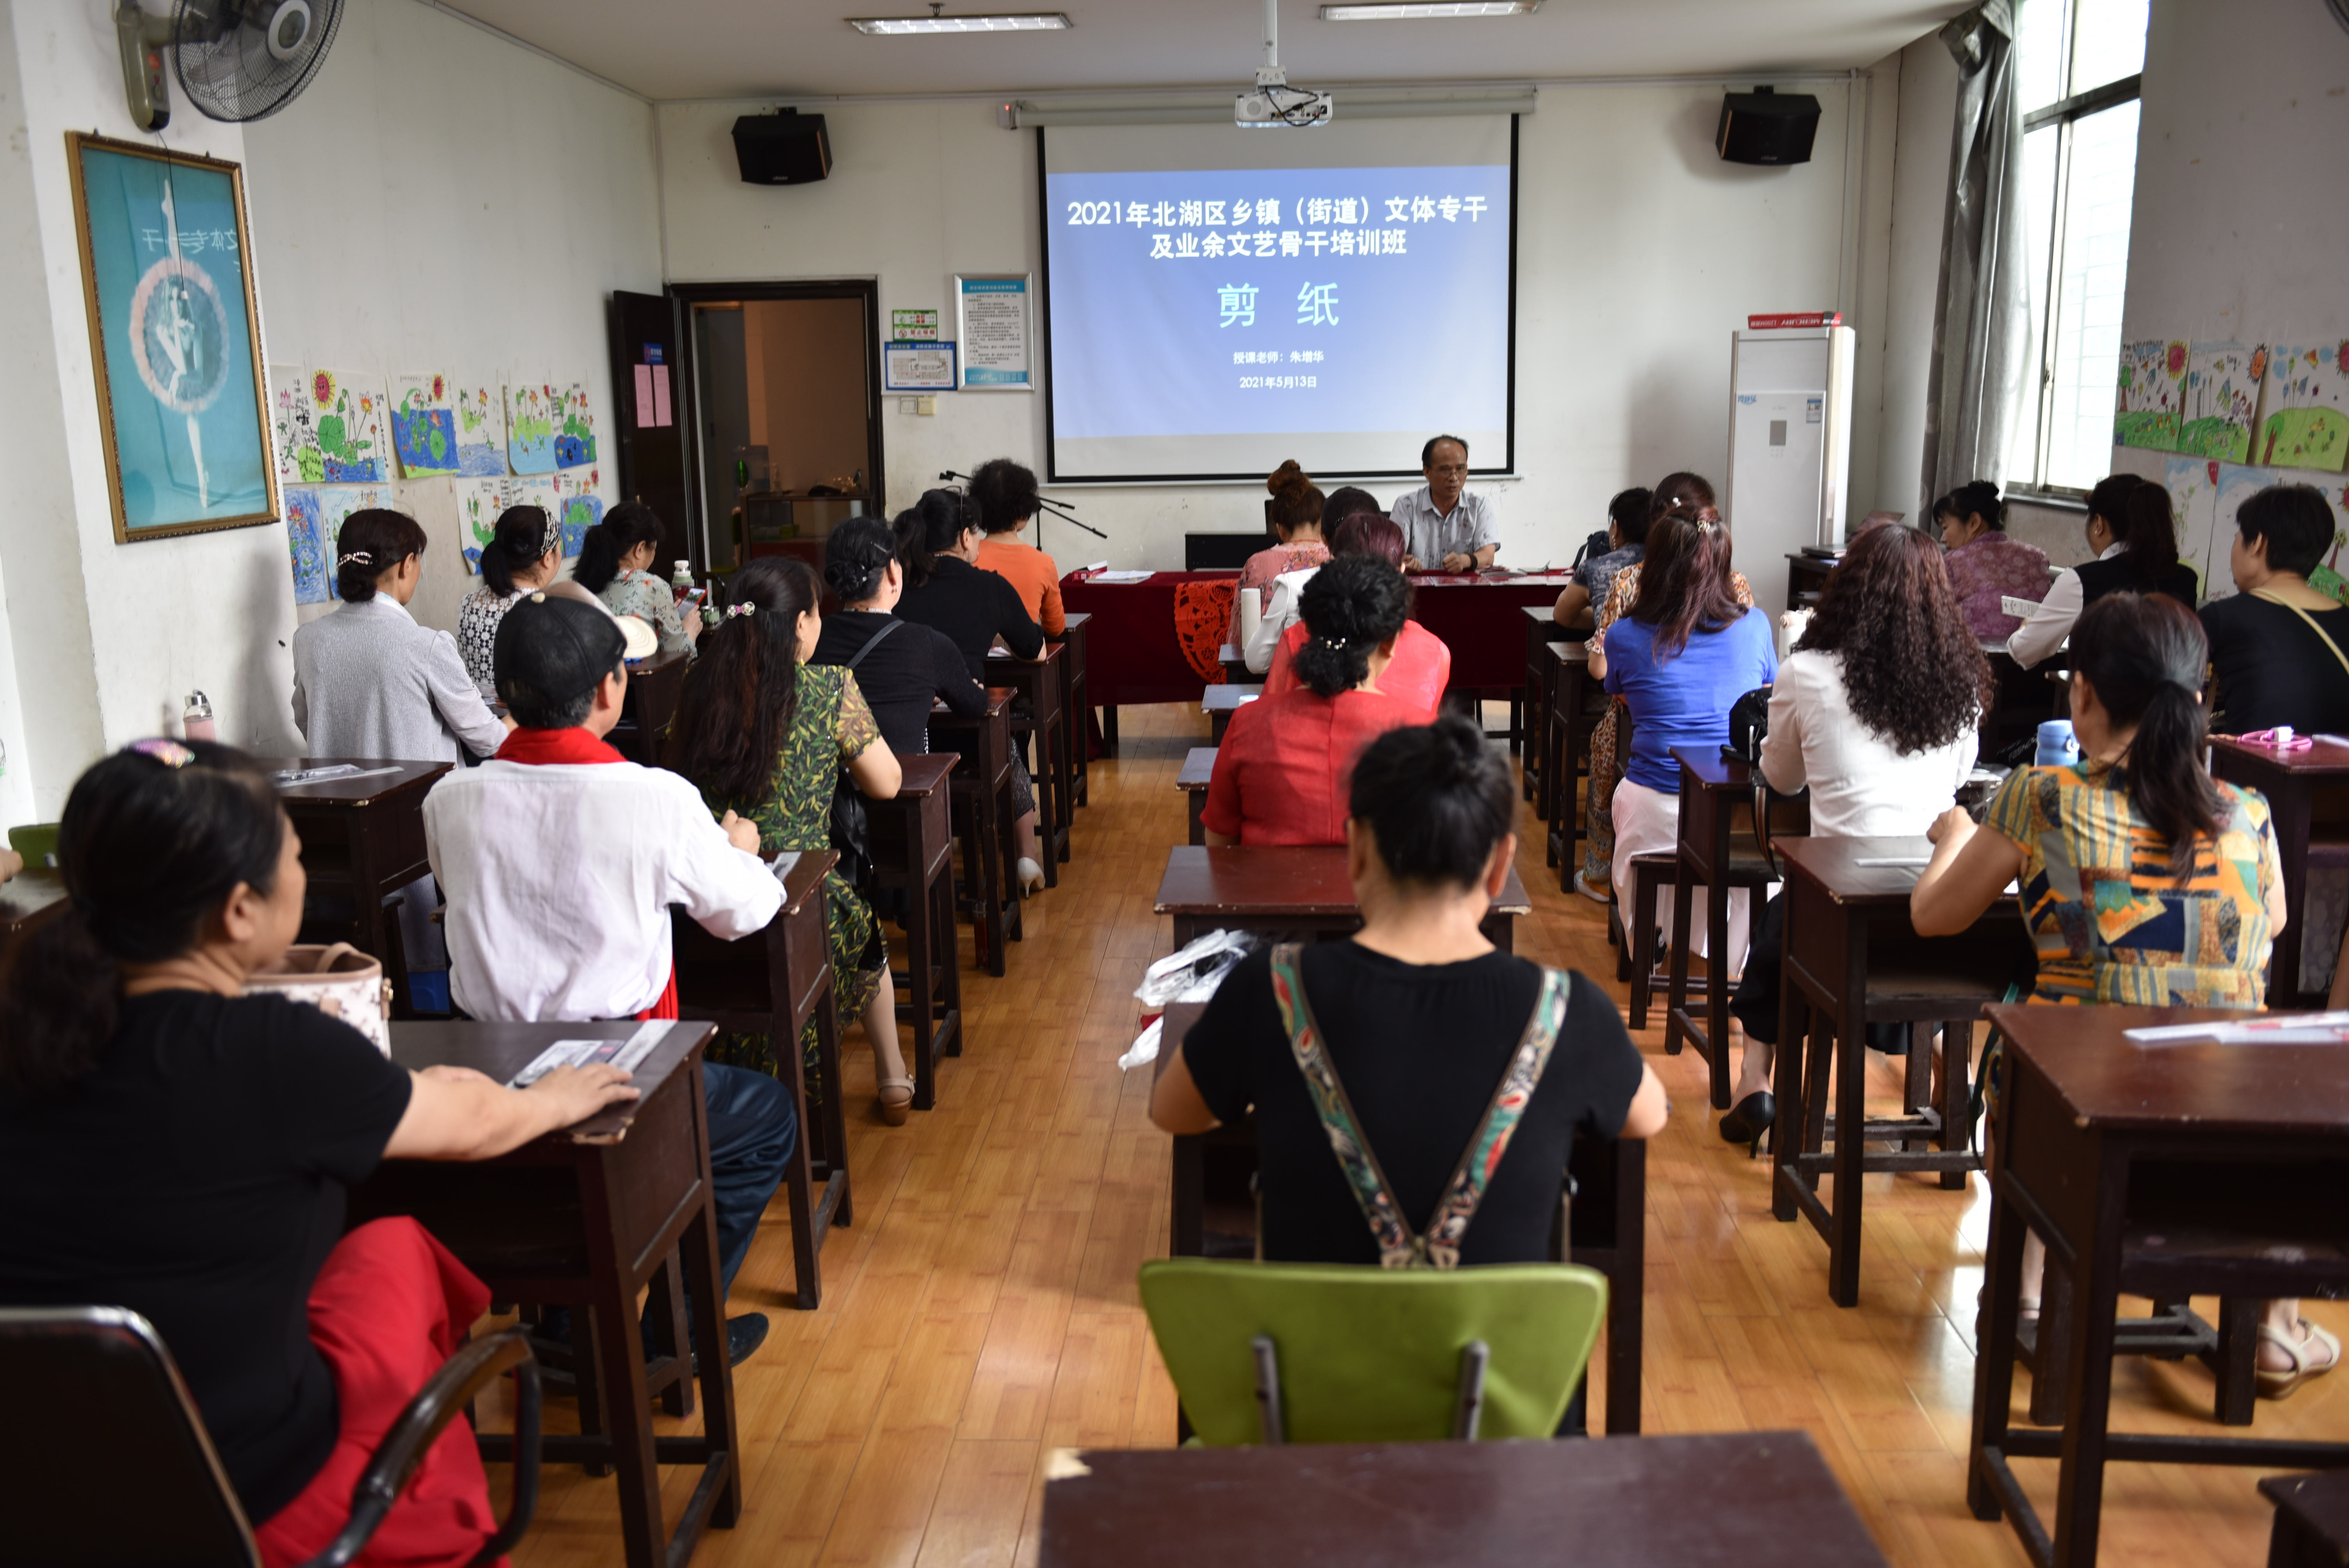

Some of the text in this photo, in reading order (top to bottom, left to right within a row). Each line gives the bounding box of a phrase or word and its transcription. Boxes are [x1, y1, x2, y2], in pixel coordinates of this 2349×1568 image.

[1068, 194, 1487, 228] 2021年北湖区乡镇（街道）文体专干
[1150, 229, 1407, 259] 及业余文艺骨干培训班
[1217, 281, 1339, 328] 剪 纸
[1233, 350, 1324, 365] 授课老师：朱增华
[1239, 376, 1317, 389] 2021年5月13日
